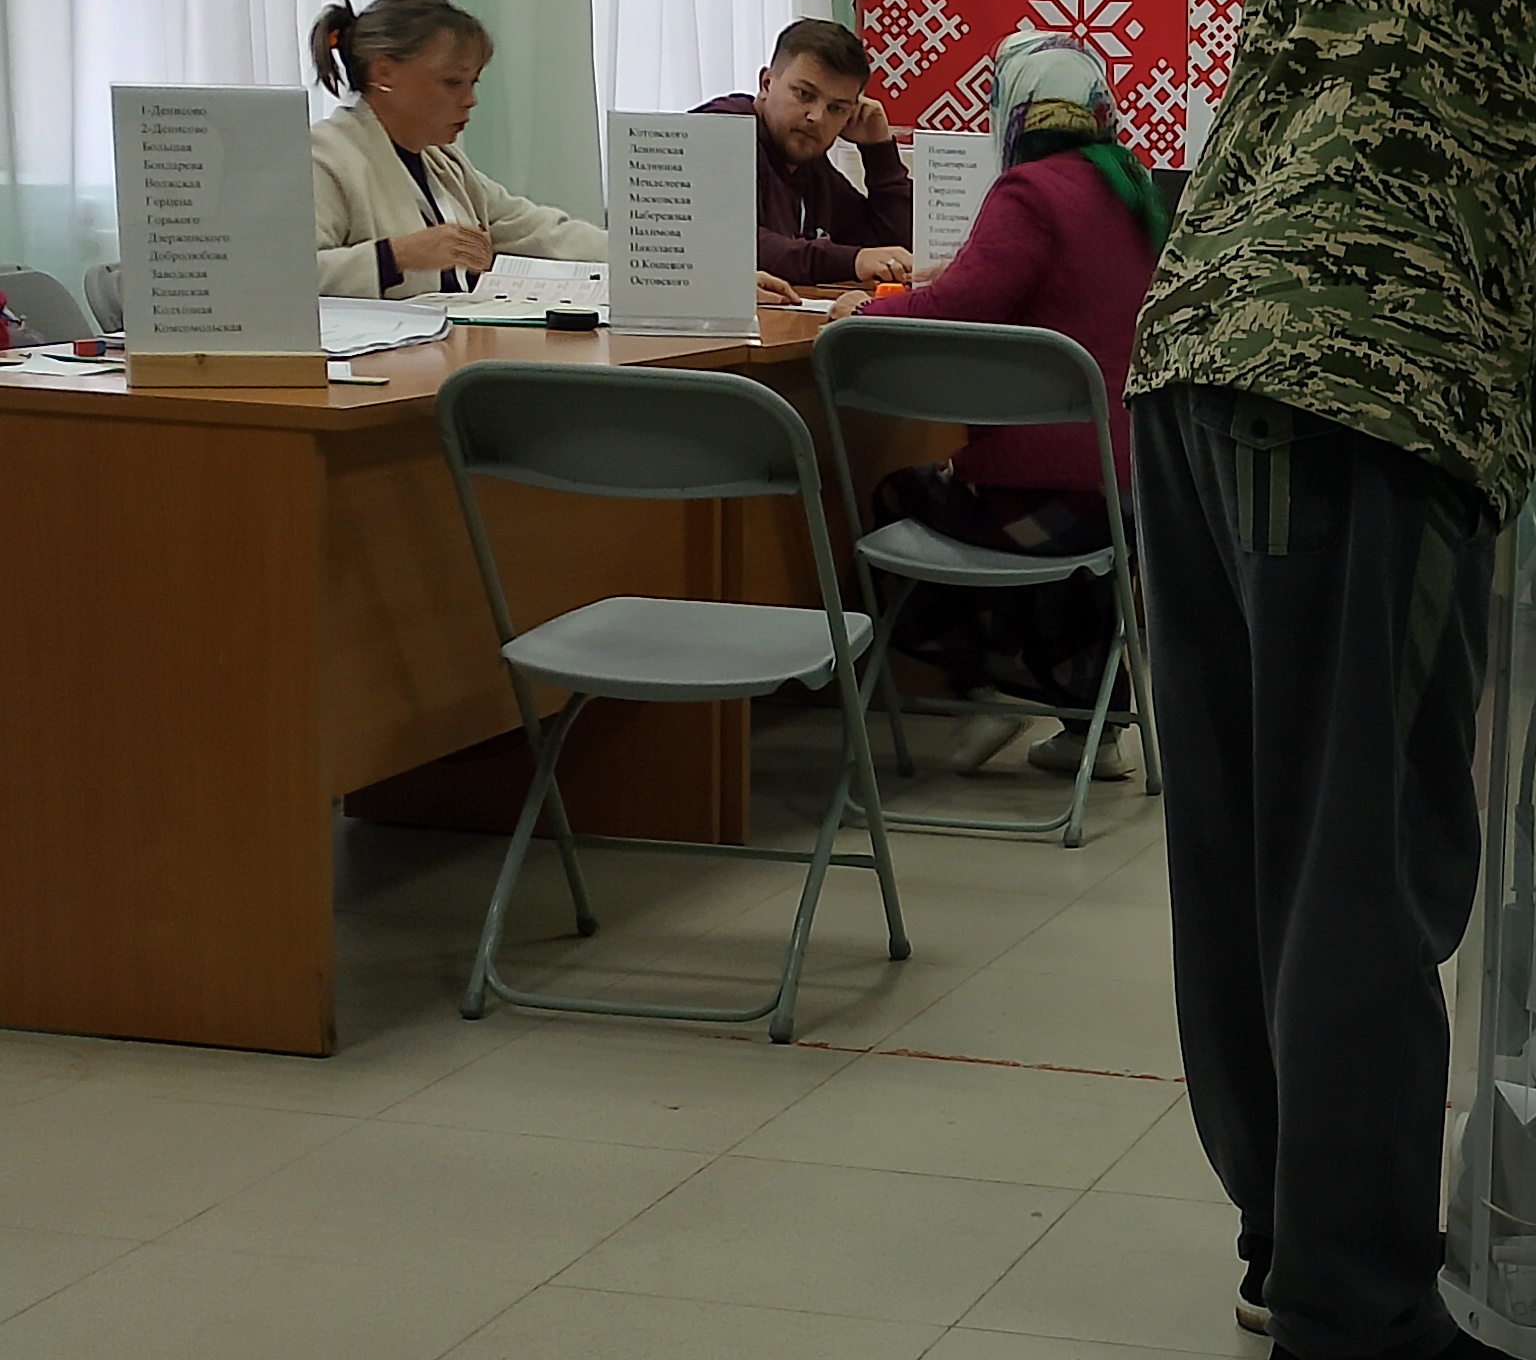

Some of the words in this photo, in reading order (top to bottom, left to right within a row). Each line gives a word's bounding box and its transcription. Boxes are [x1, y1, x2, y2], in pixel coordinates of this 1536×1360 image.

[141, 104, 208, 118] 1-Денисово
[140, 122, 208, 135] 2-Денисово
[145, 195, 193, 210] Герцена
